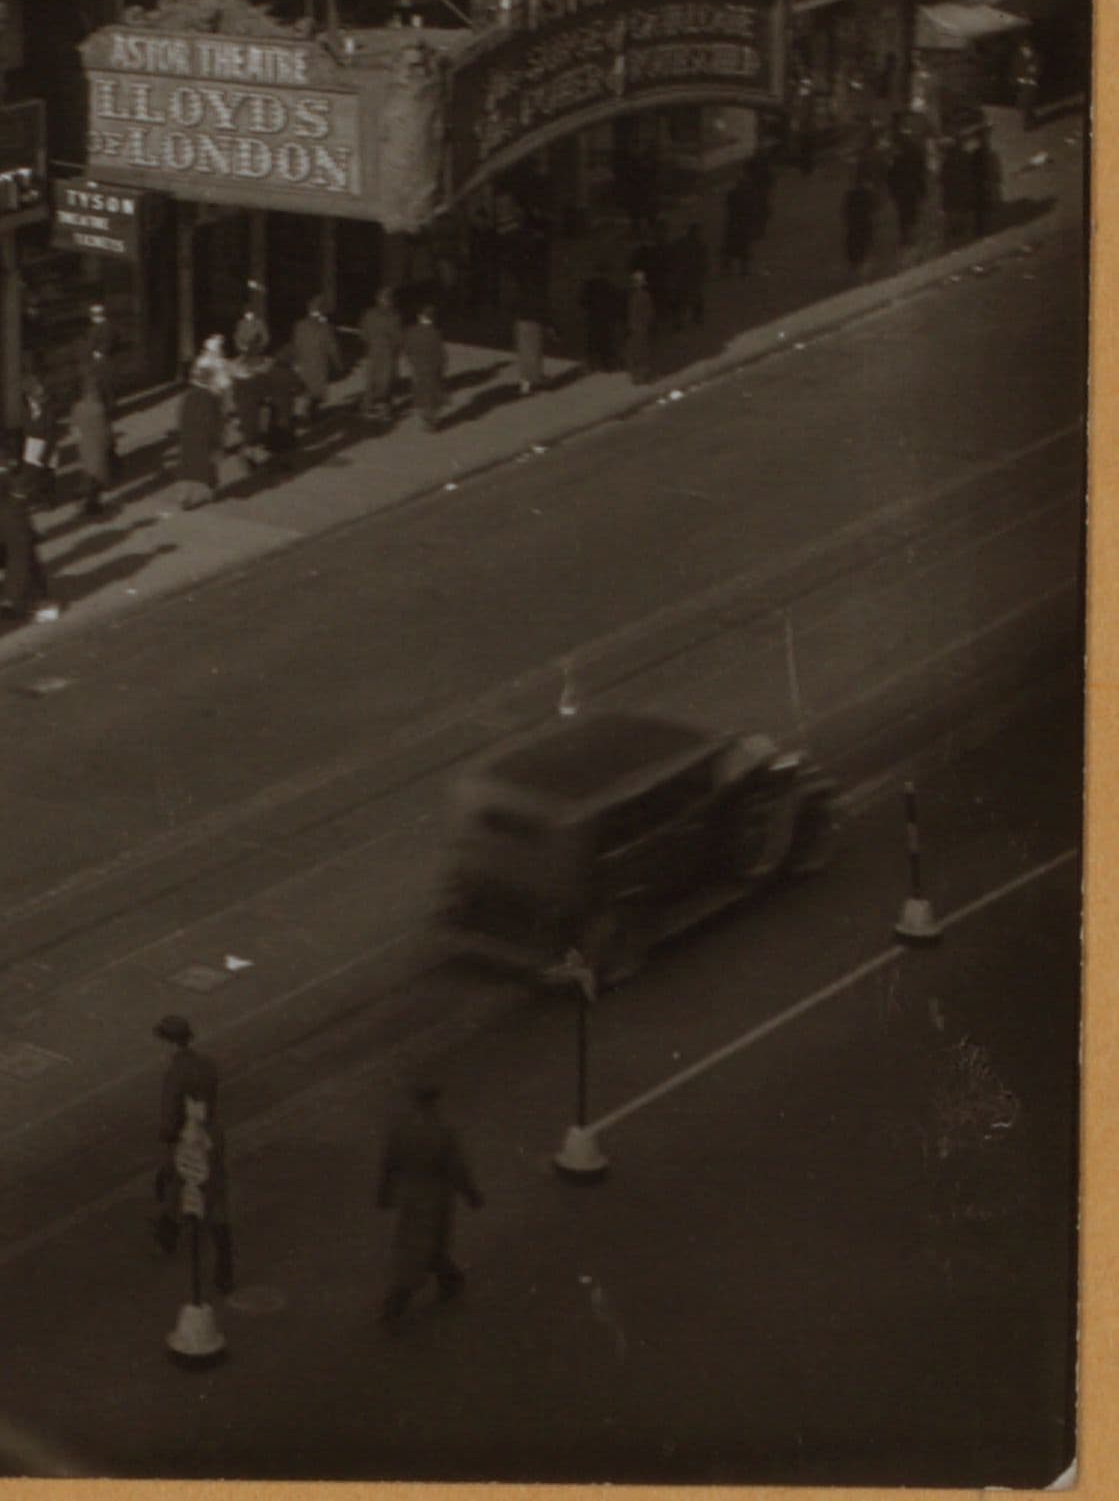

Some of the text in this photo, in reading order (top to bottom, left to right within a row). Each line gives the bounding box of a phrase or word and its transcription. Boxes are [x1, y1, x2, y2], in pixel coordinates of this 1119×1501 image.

[110, 32, 312, 85] ASTOR THEATRE
[94, 78, 331, 140] LLOYDS
[88, 126, 353, 194] OF LONDON
